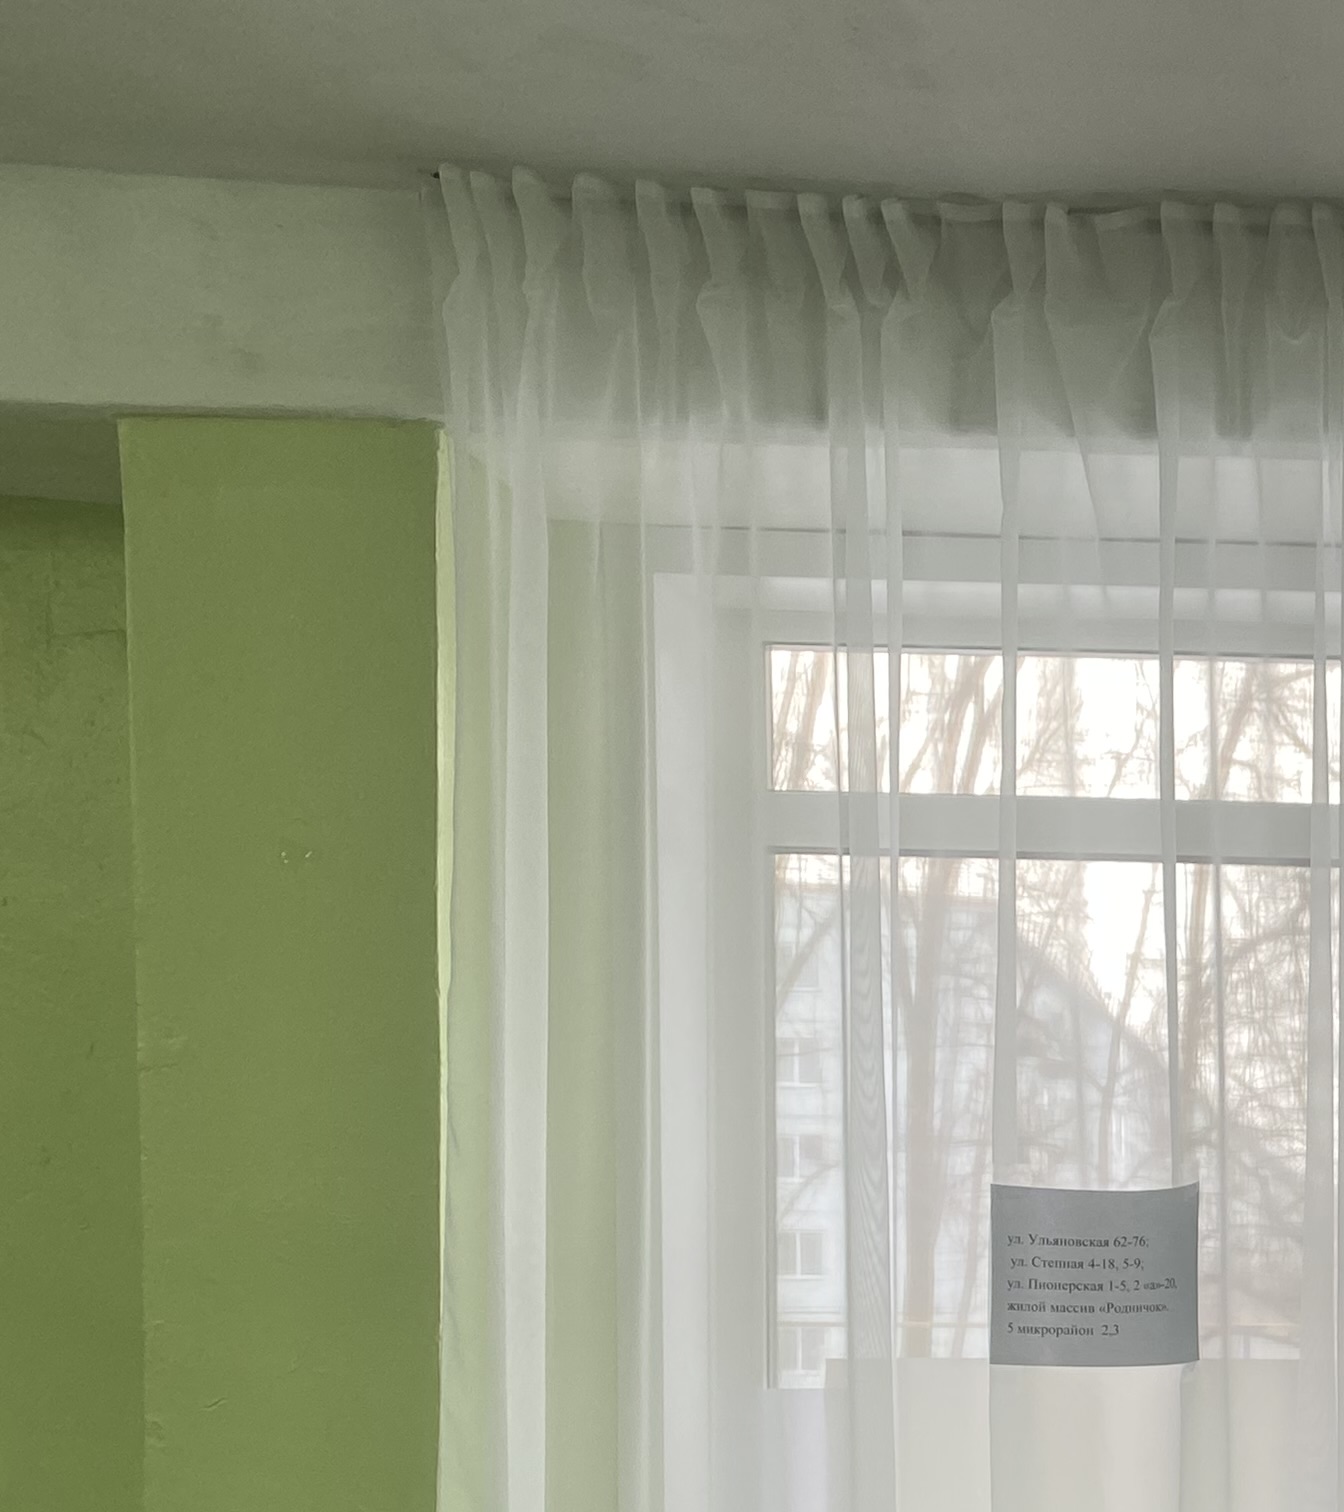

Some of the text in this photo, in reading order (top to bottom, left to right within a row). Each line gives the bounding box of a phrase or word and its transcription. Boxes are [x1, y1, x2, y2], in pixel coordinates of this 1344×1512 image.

[1007, 1234, 1024, 1246] ул.
[1028, 1233, 1110, 1248] Ульяновская
[1031, 1256, 1084, 1270] Степная
[1028, 1278, 1104, 1294] Пионерская
[1007, 1301, 1046, 1313] жилой
[1050, 1303, 1095, 1314] массив
[1007, 1322, 1014, 1334] 5
[1017, 1324, 1094, 1338] микрорайон
